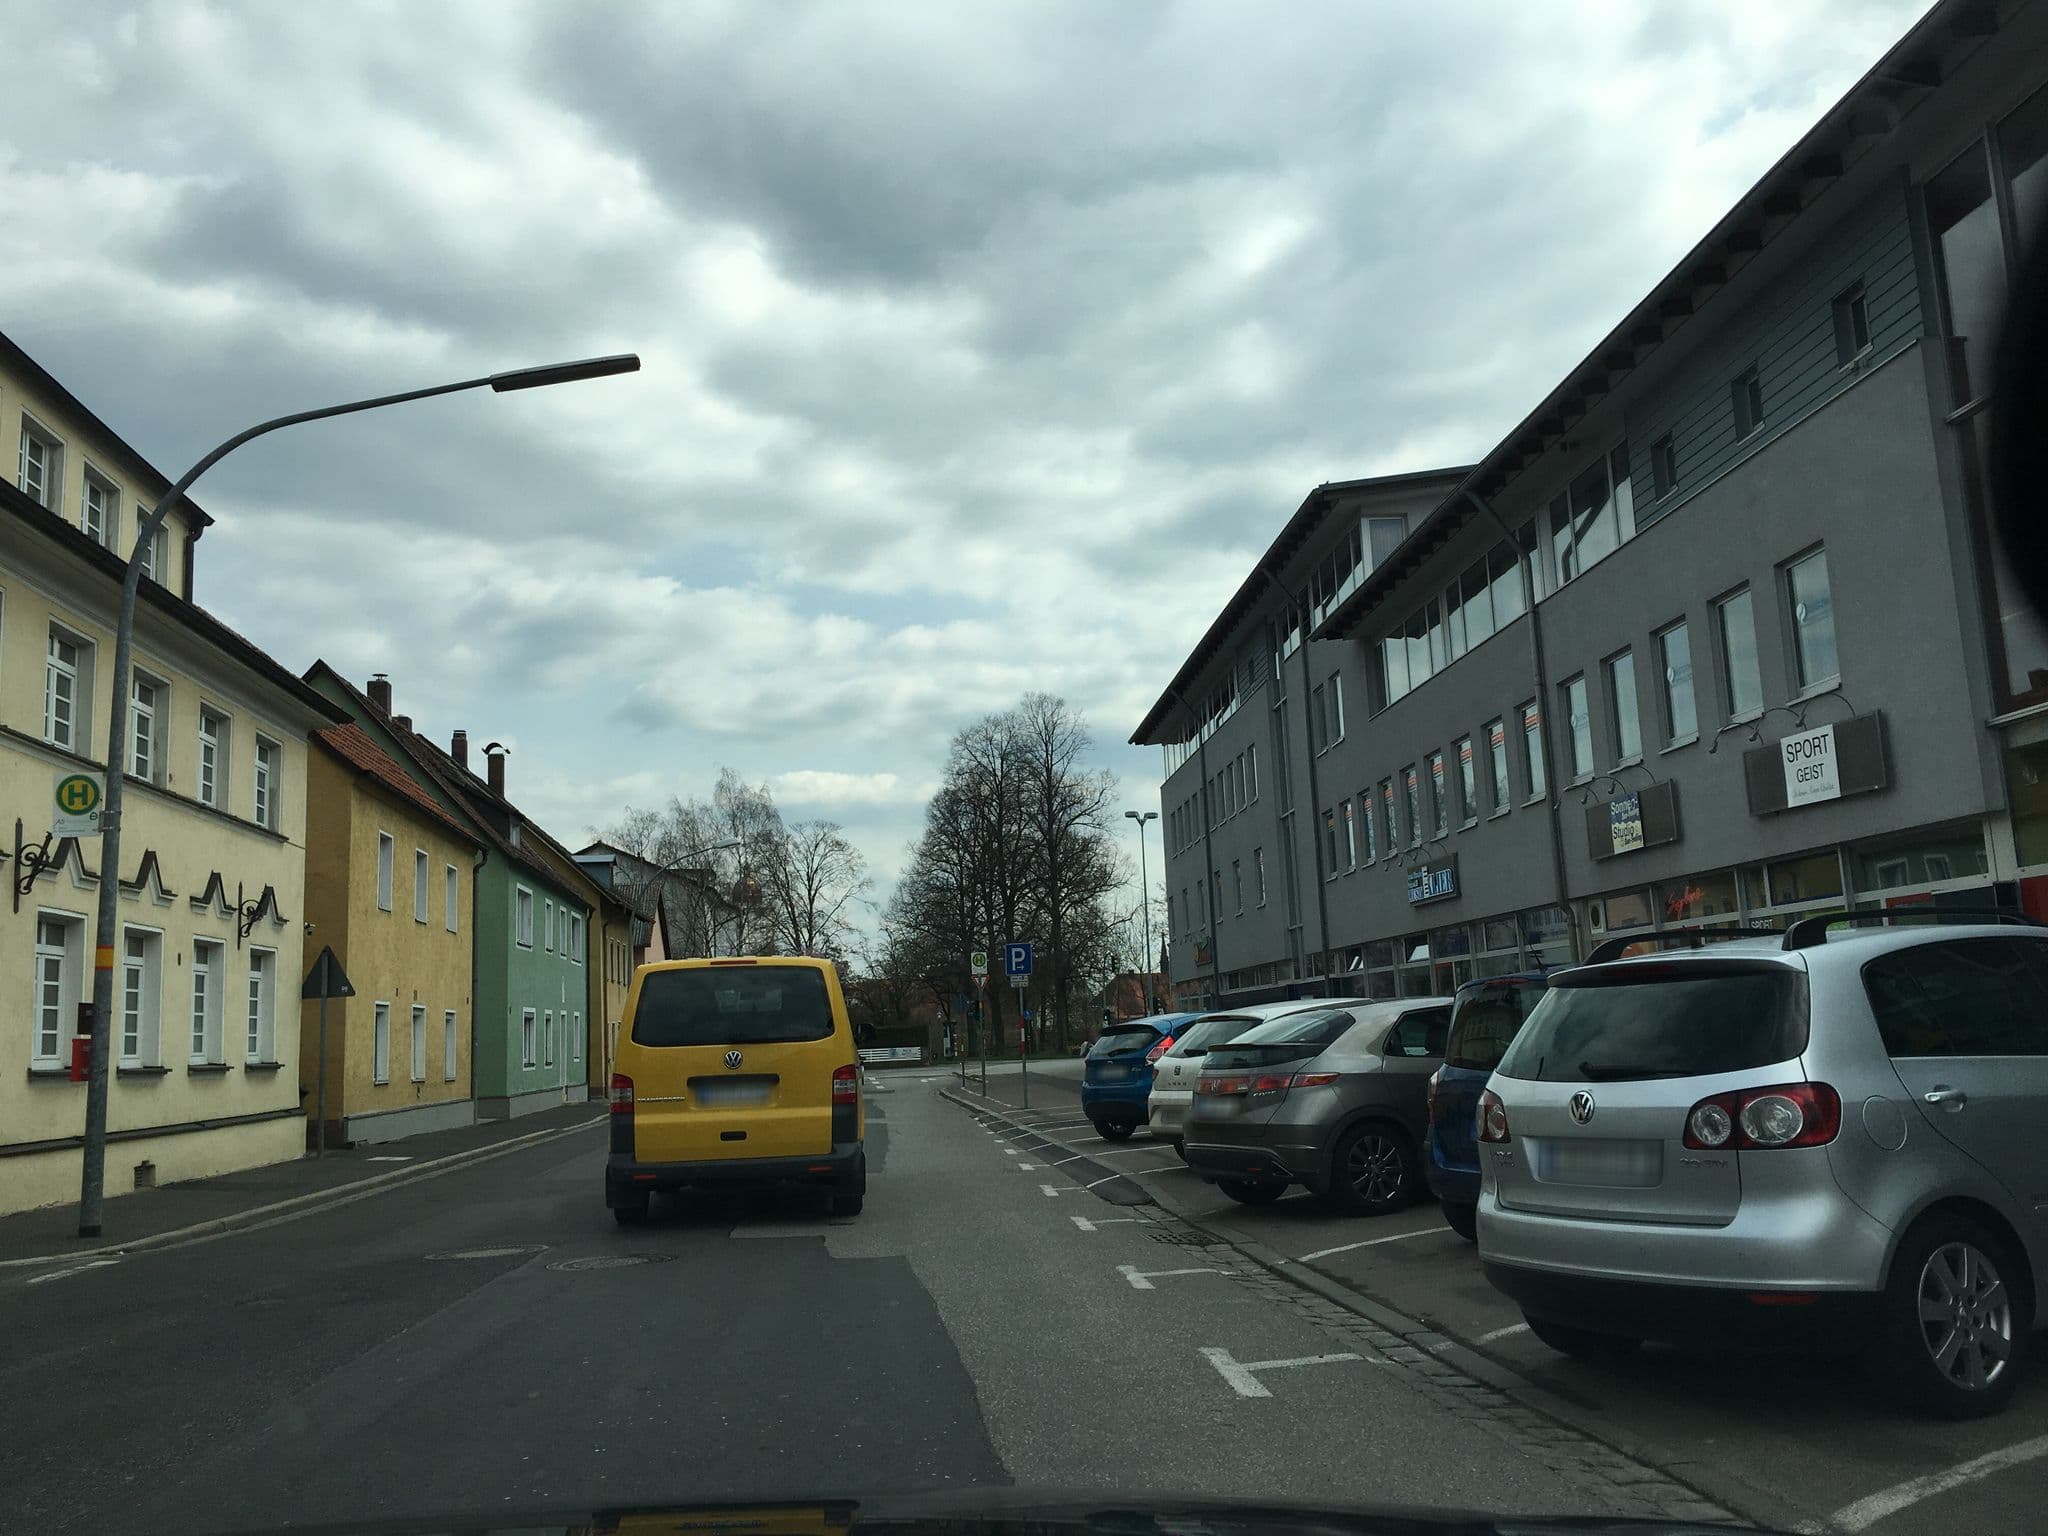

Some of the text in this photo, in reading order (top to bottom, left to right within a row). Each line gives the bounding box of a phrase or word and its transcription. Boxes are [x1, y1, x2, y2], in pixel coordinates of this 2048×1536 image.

[1786, 734, 1829, 763] SPORT
[1796, 763, 1824, 783] GEIST
[68, 784, 88, 806] H
[1011, 947, 1026, 971] P
